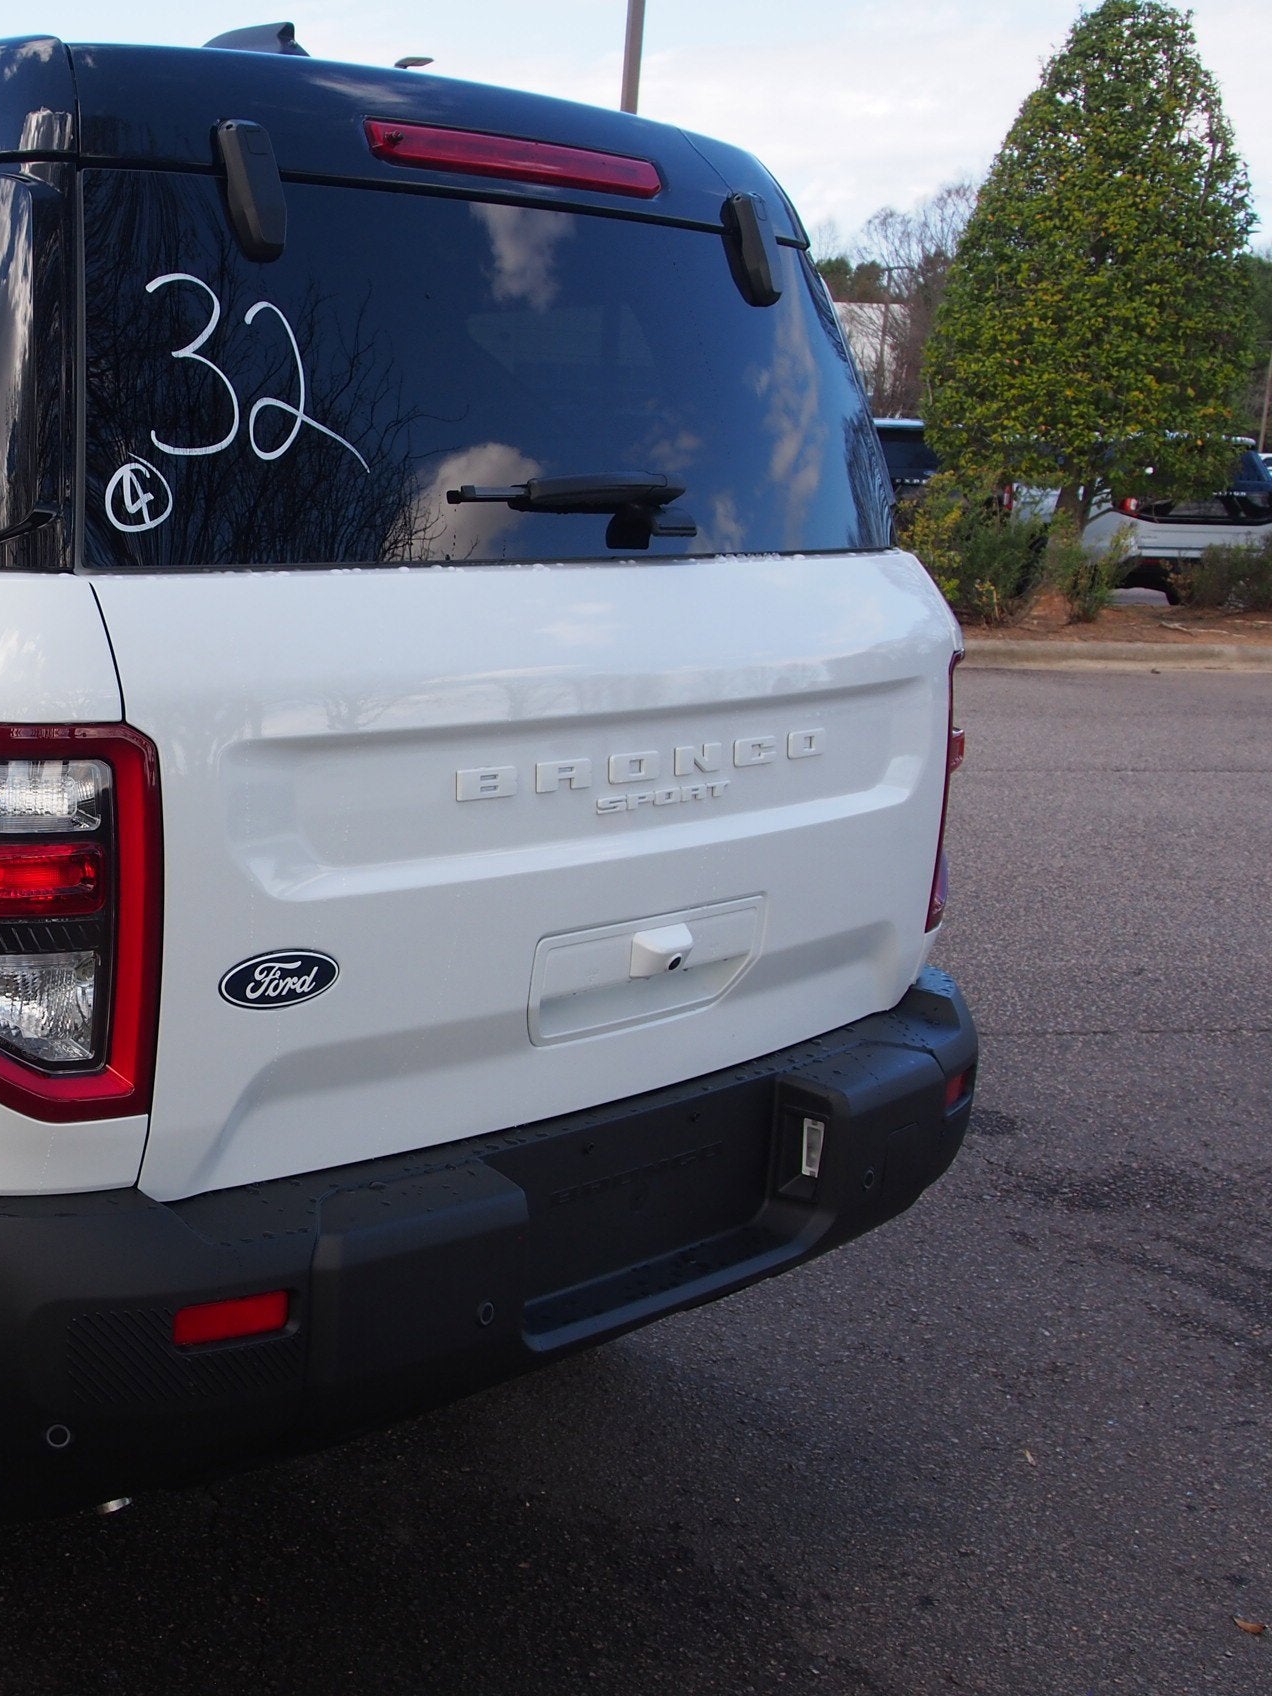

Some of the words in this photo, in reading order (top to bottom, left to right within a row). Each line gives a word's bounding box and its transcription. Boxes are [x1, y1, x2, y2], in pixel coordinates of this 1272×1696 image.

[145, 272, 370, 474] 32
[456, 727, 825, 801] BRONCO
[596, 780, 730, 815] SPORT
[245, 960, 319, 1000] Ford
